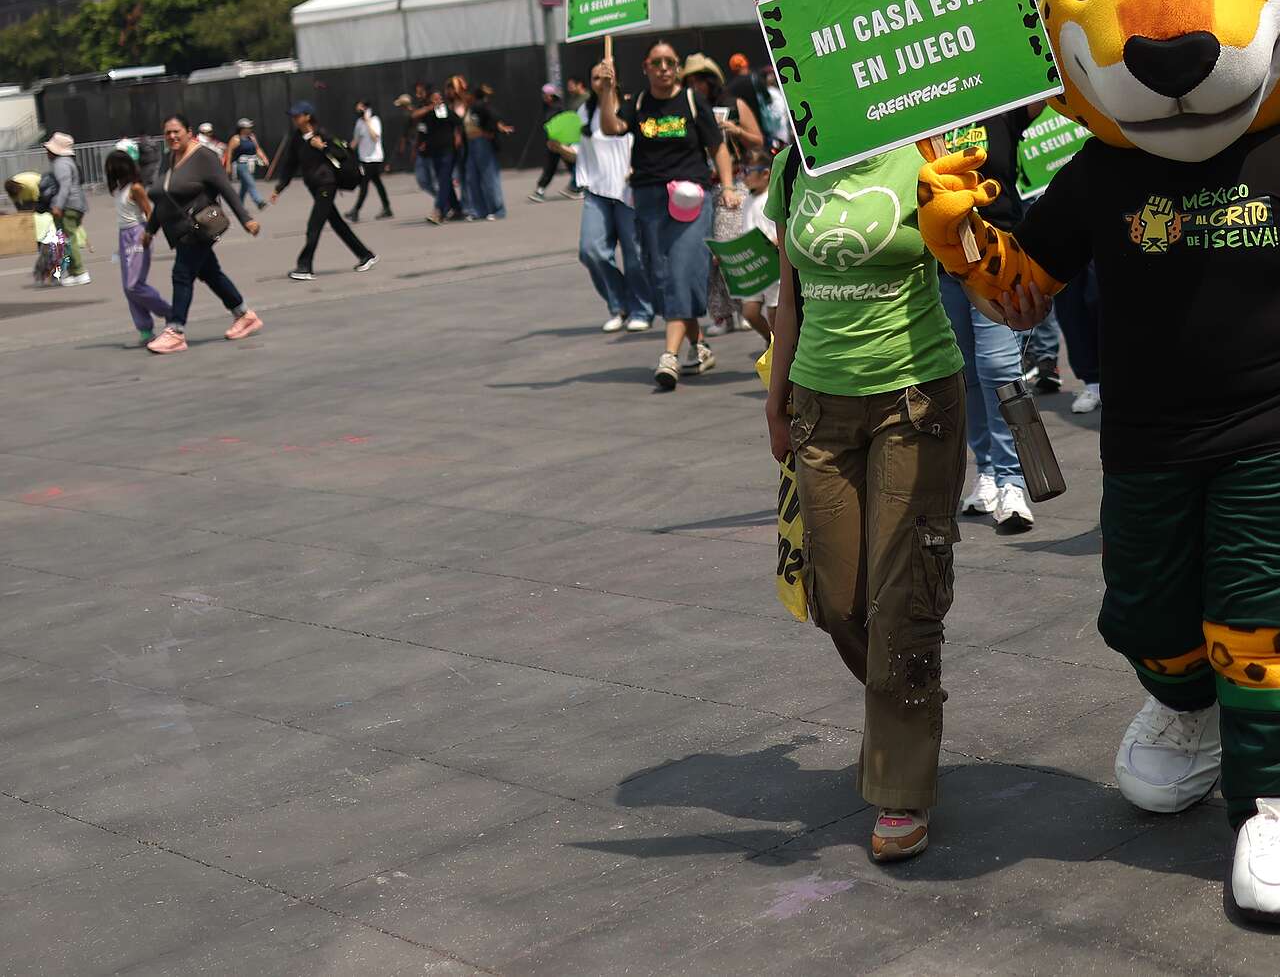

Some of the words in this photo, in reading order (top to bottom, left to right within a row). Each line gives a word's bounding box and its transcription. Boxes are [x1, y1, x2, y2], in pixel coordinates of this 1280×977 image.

[579, 3, 589, 14] LA
[810, 24, 847, 57] MI
[851, 53, 888, 89] EN
[897, 24, 977, 75] JUEGO
[1022, 115, 1072, 142] PROTEJA
[1024, 145, 1040, 160] LA
[1040, 132, 1074, 153] SELVA
[1195, 215, 1207, 225] AL
[1186, 236, 1200, 247] DE
